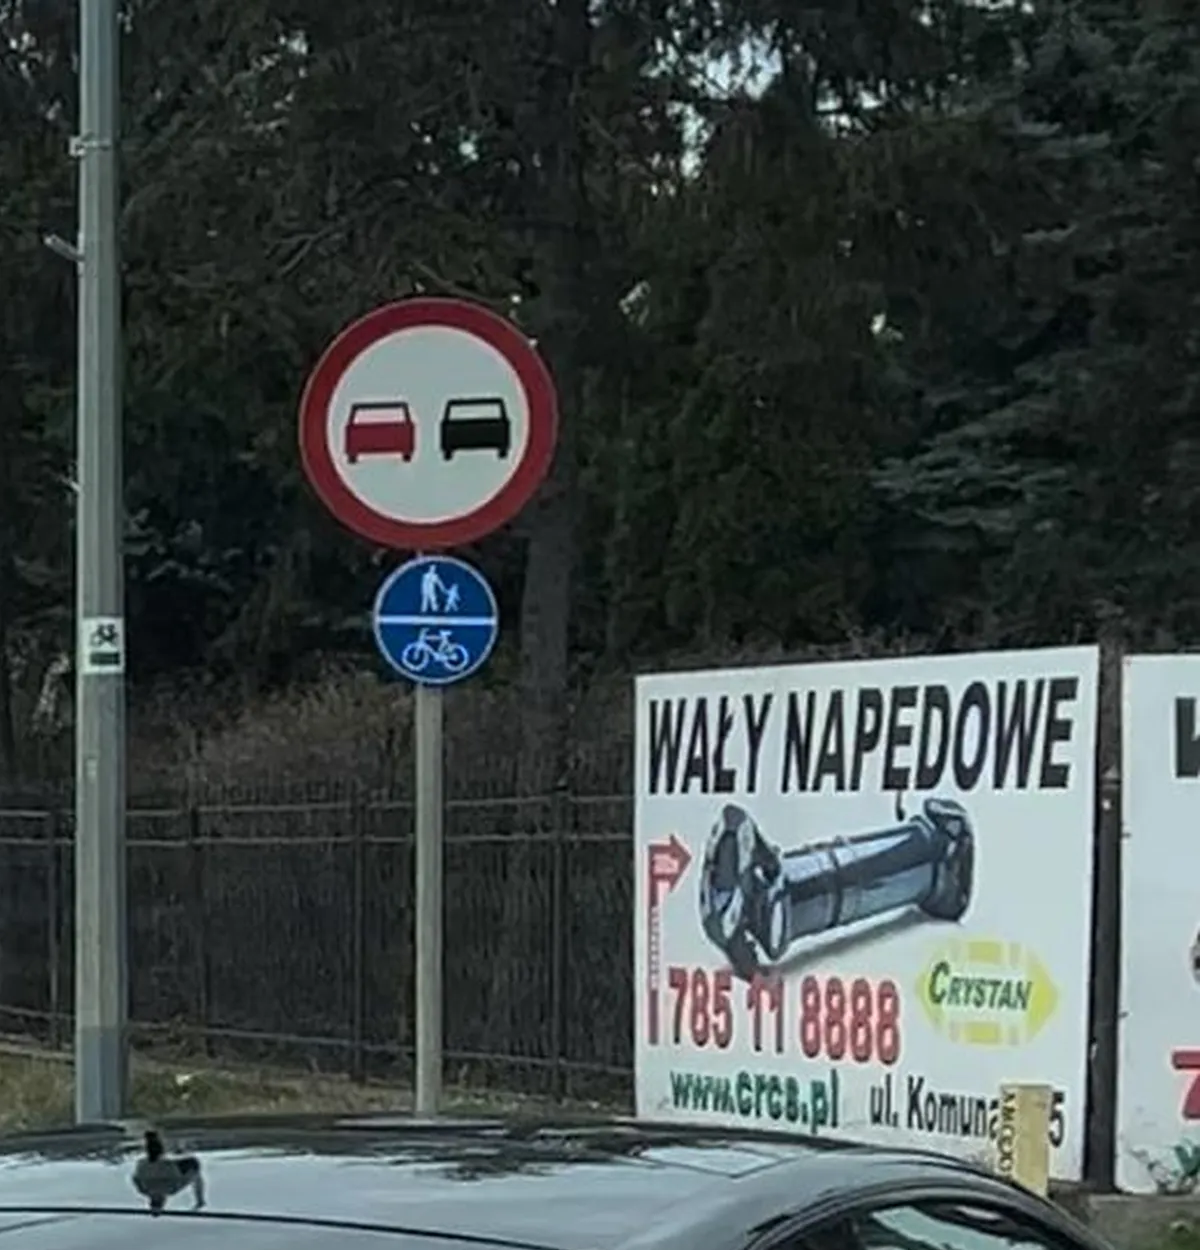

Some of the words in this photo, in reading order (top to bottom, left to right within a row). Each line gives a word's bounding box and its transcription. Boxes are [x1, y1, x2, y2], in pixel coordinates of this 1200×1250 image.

[648, 692, 772, 795] WAŁY
[780, 676, 1079, 821] NAPĘDOWE
[668, 966, 734, 1049] 785
[746, 968, 785, 1054] 11
[799, 974, 901, 1066] 8888
[870, 1073, 899, 1128] ul.
